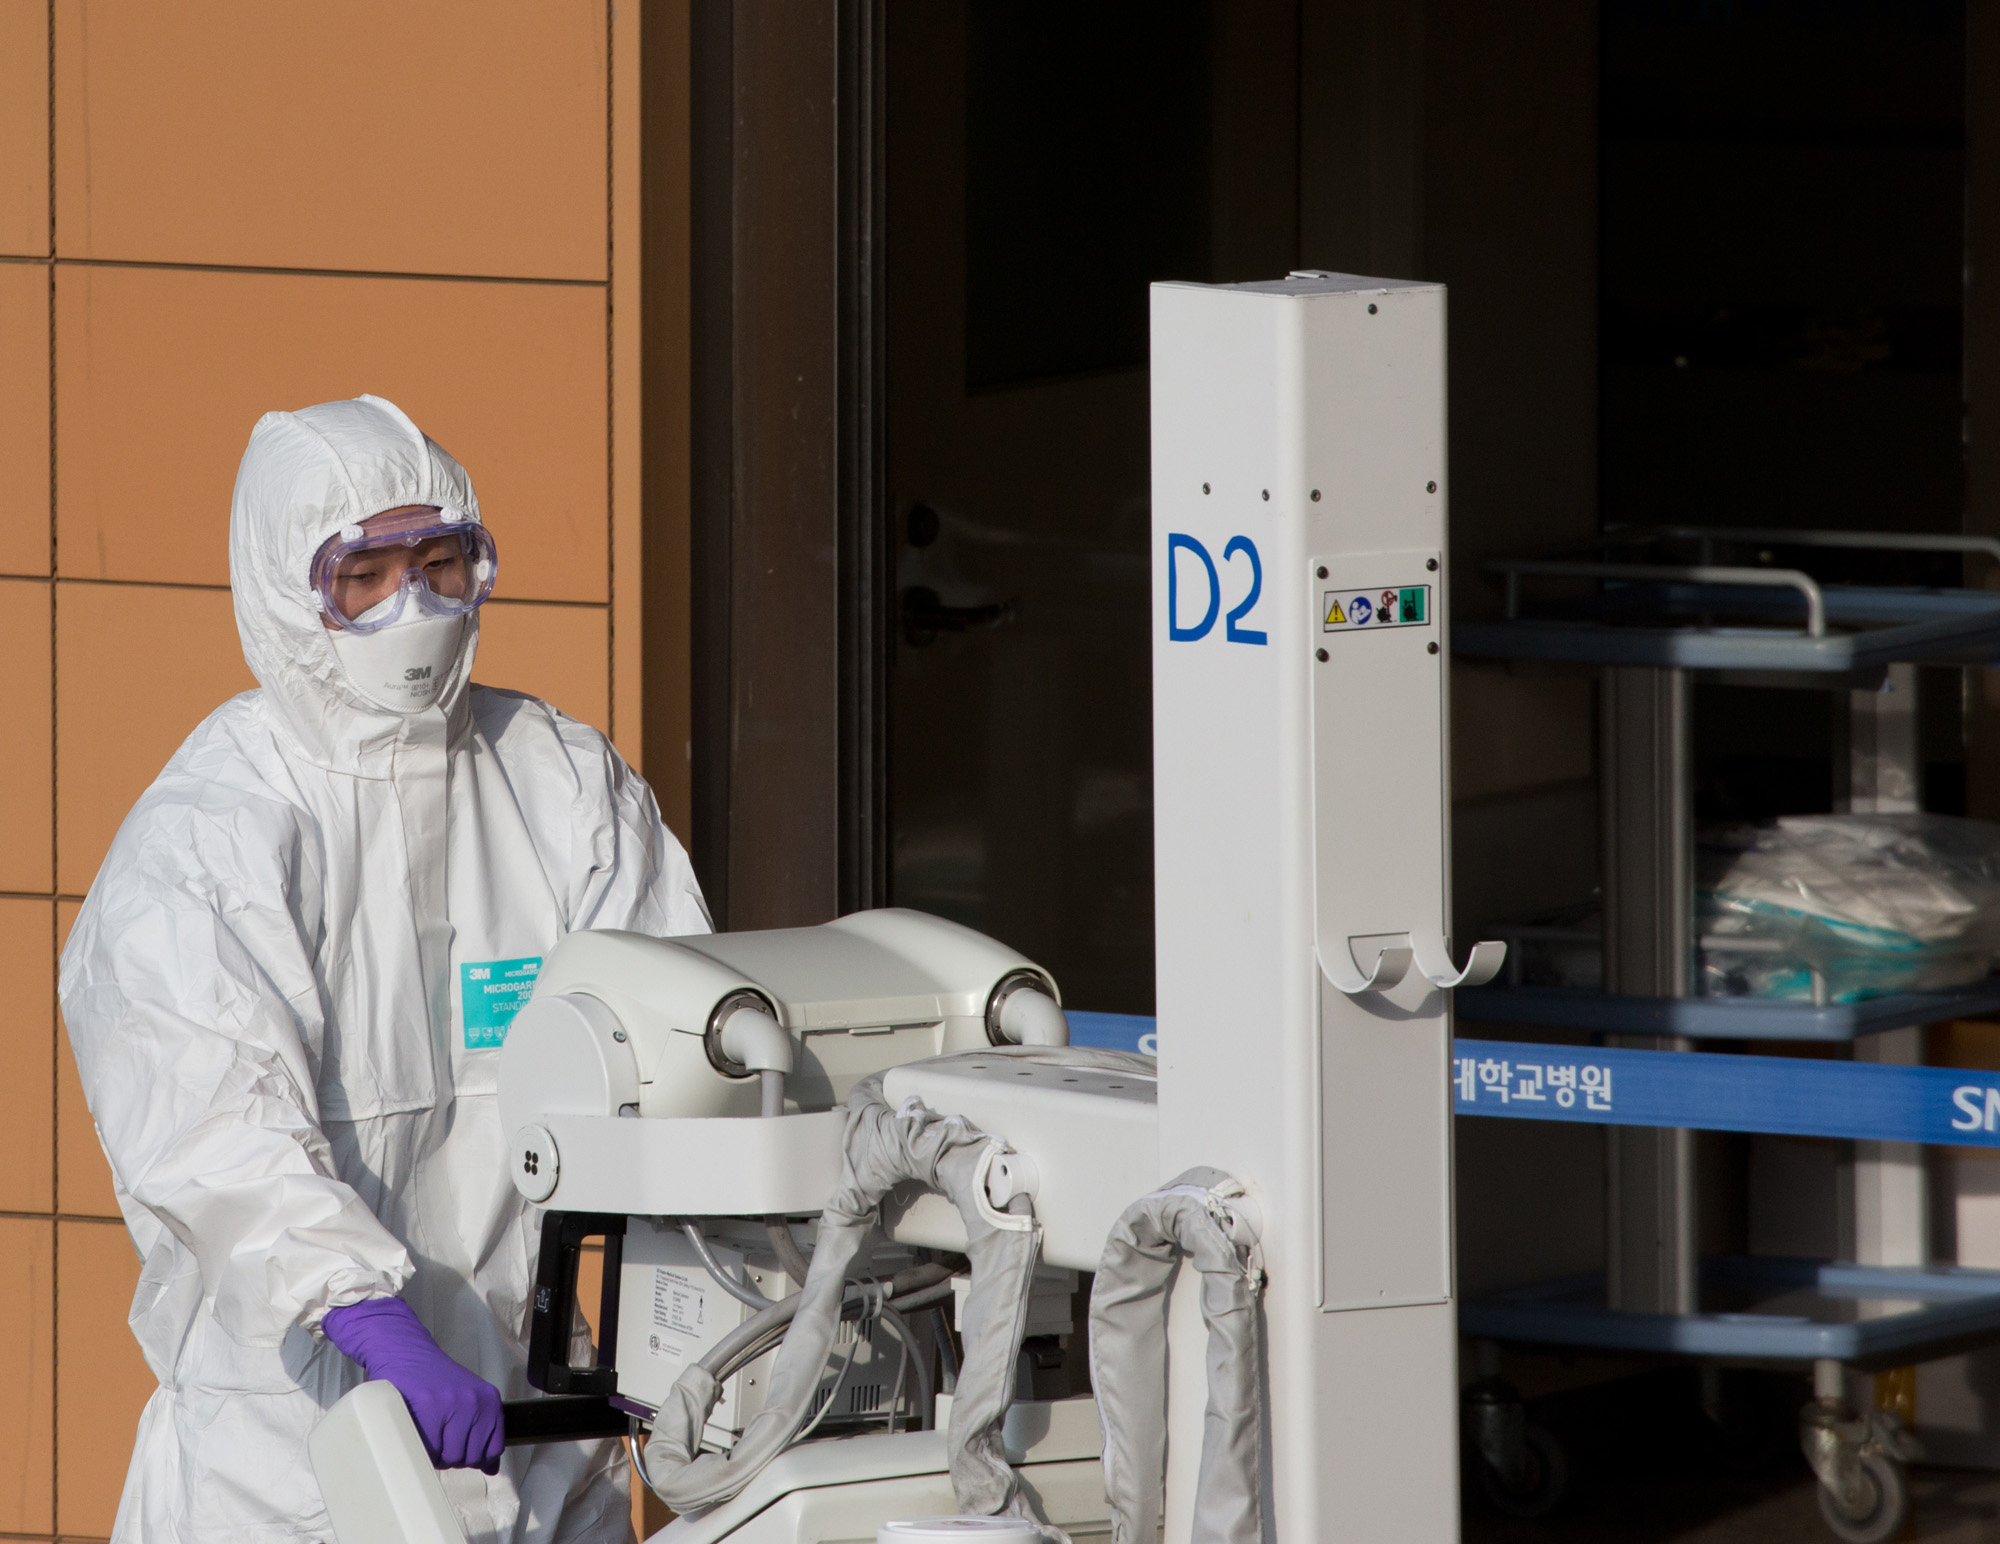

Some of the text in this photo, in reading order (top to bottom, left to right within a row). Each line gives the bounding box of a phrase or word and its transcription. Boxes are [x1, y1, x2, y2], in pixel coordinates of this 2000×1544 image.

[1168, 533, 1267, 645] D2
[404, 665, 431, 681] 3M
[469, 968, 490, 980] 3M
